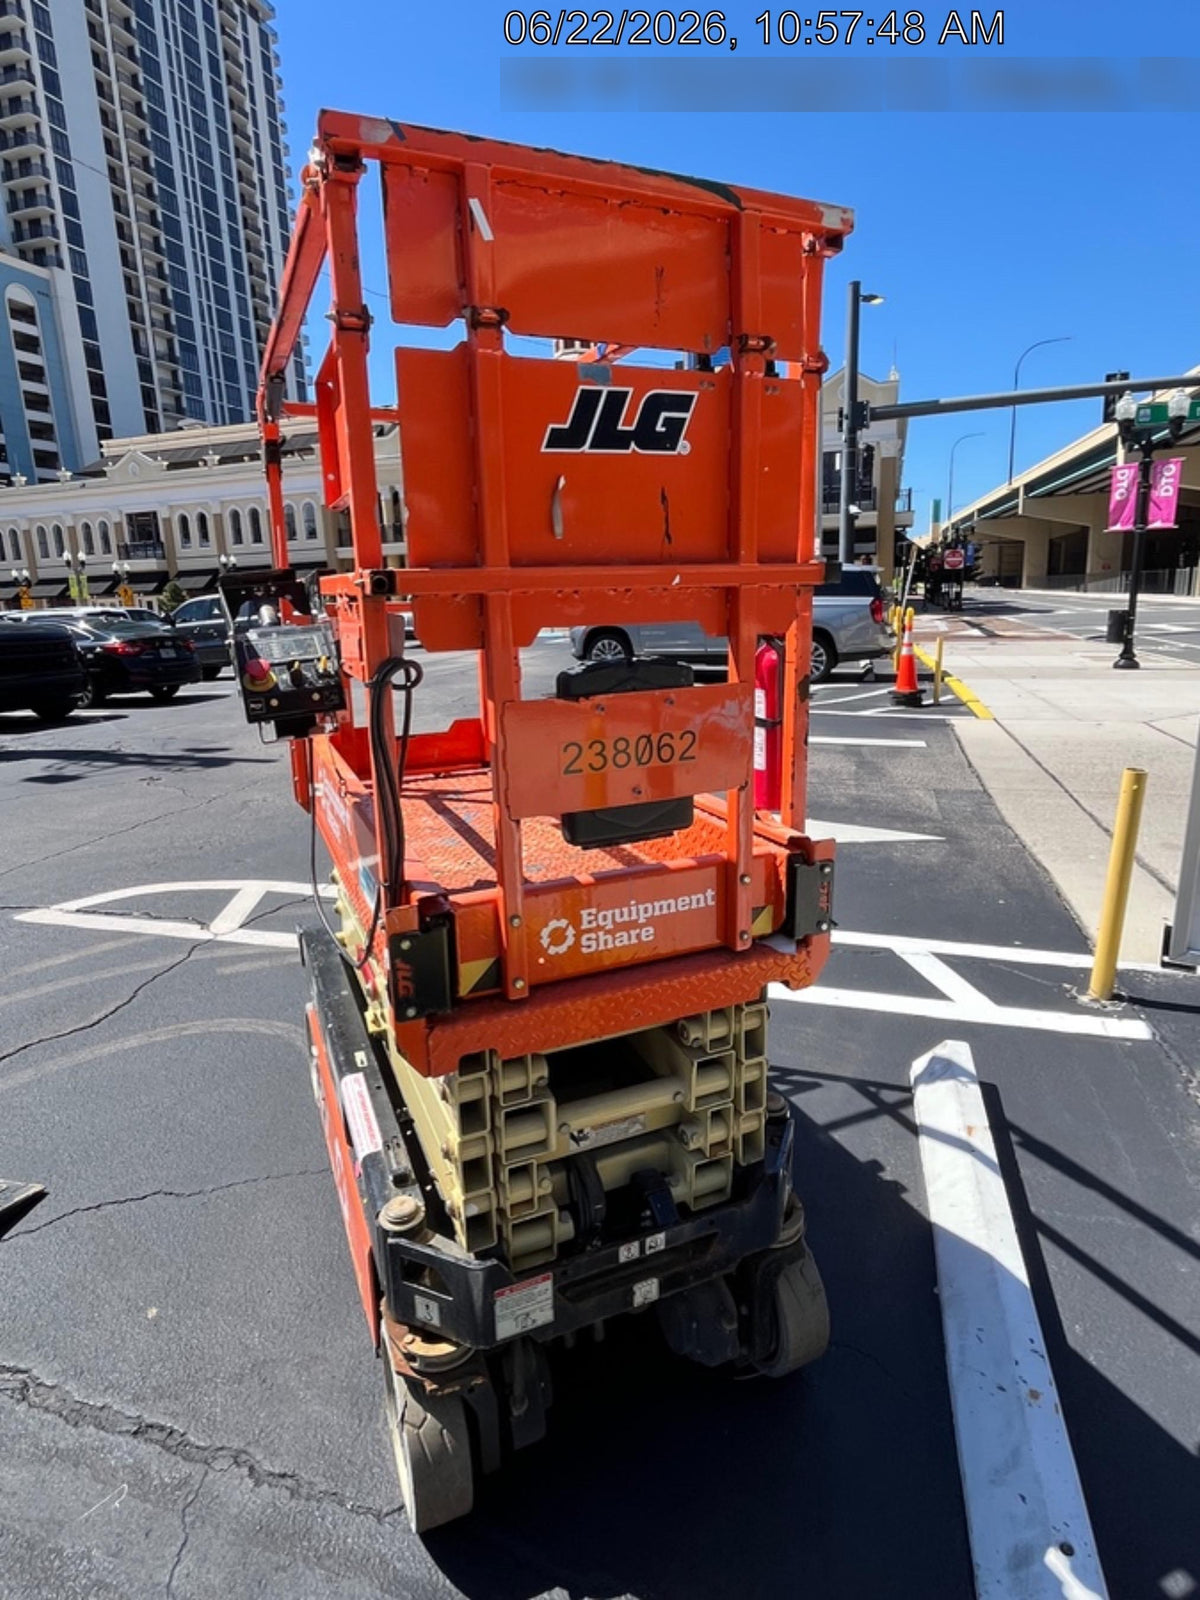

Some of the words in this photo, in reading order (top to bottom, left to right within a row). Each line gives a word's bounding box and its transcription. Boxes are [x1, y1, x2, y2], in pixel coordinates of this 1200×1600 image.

[540, 385, 700, 455] JLG
[1115, 468, 1130, 500] DTO
[1159, 463, 1177, 497] DTO
[580, 888, 716, 930] Equipment
[580, 925, 655, 954] Share
